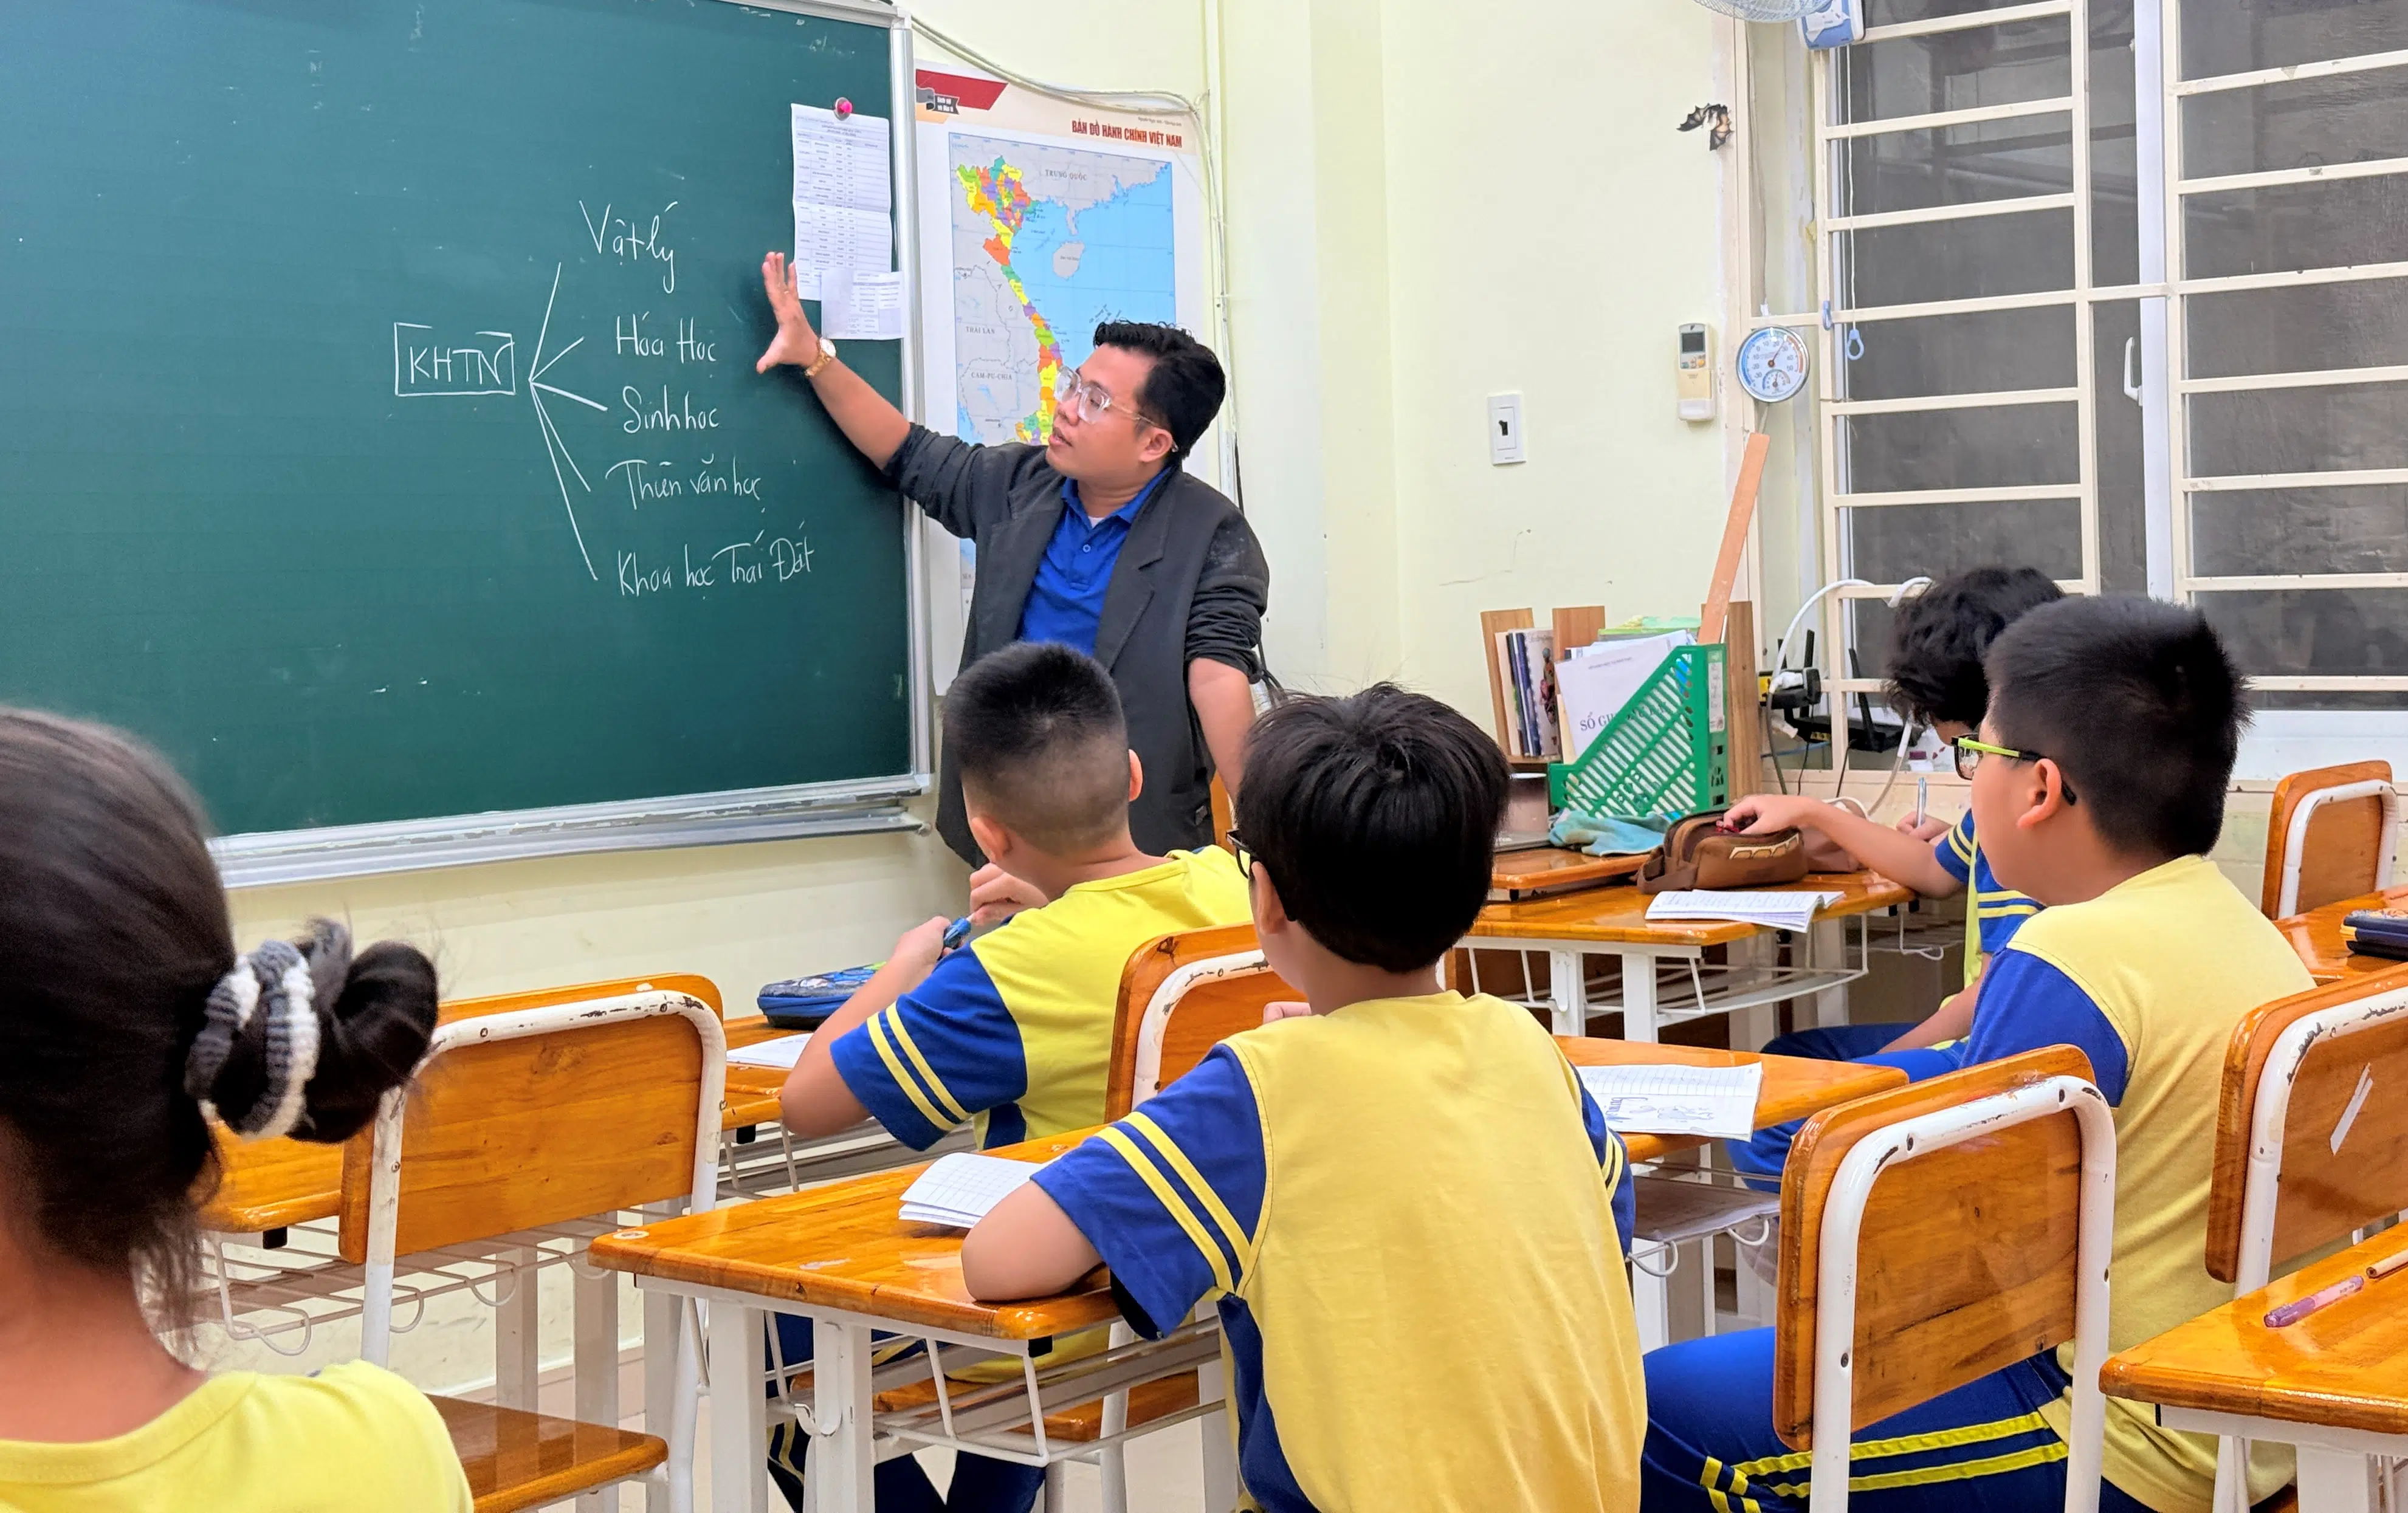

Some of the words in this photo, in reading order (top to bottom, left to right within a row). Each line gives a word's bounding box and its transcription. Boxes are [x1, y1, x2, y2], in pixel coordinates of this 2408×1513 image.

[1102, 123, 1123, 139] HÀNH
[1124, 126, 1147, 143] CHÍNH
[1149, 130, 1164, 148] VIỆT
[1166, 134, 1183, 148] NAM
[579, 200, 645, 266] Vật
[645, 201, 678, 294] lý
[616, 310, 664, 357] Hóa
[410, 341, 515, 385] KHTN
[622, 384, 681, 434] Sinh
[689, 453, 727, 495] văn
[617, 549, 672, 597] Khoa
[711, 529, 765, 583] Trái
[769, 520, 815, 583] Đất
